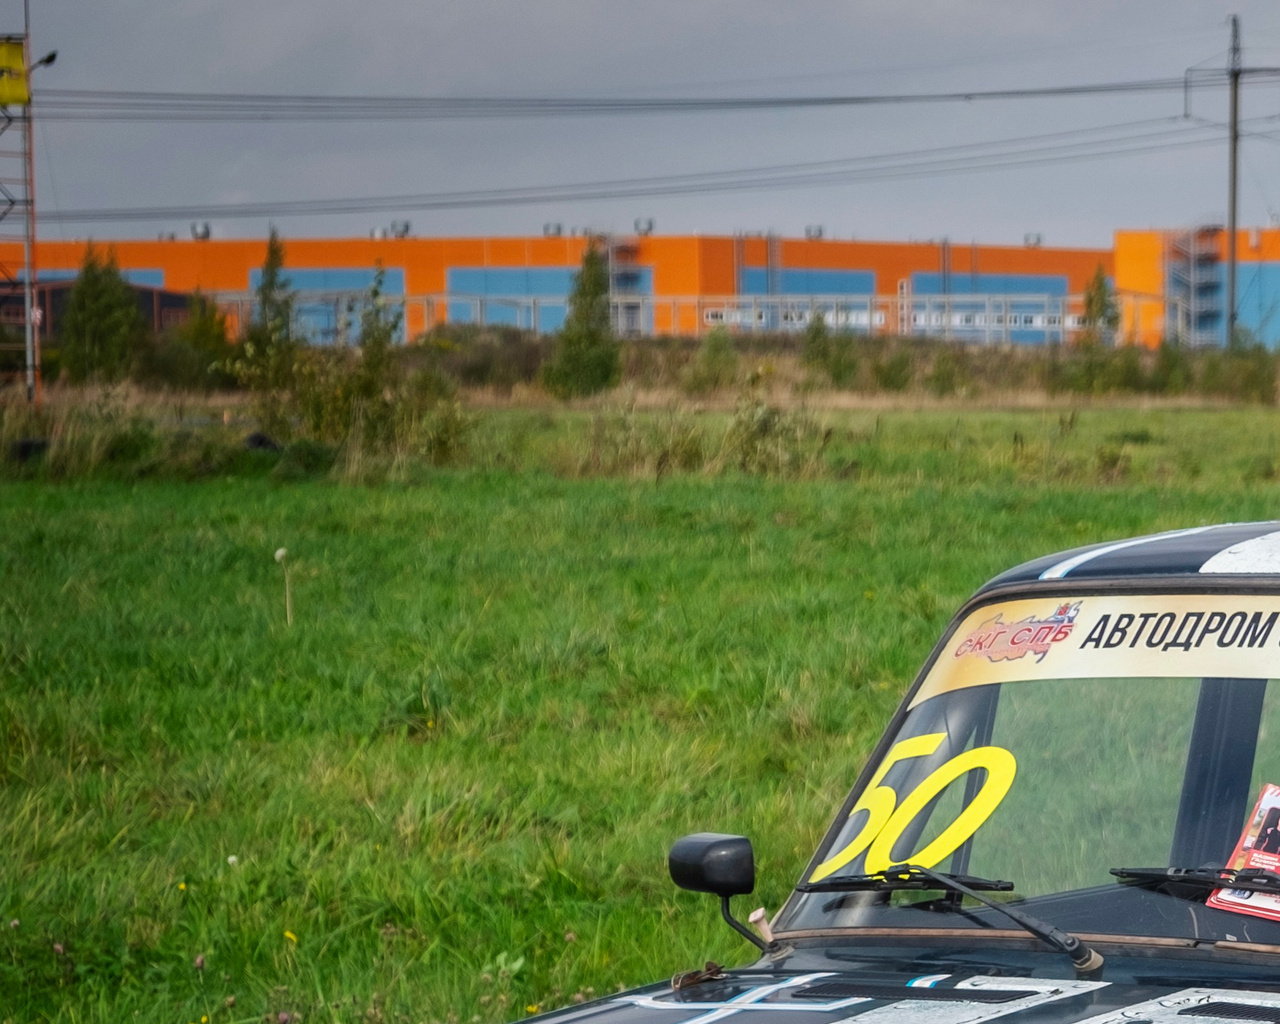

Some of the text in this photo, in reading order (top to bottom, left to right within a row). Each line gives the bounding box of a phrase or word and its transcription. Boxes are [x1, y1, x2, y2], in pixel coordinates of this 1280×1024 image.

[954, 629, 1007, 659] СКГ
[1008, 621, 1077, 647] СПБ
[1079, 611, 1280, 652] АВТОДРОМ
[808, 732, 1016, 884] 50
